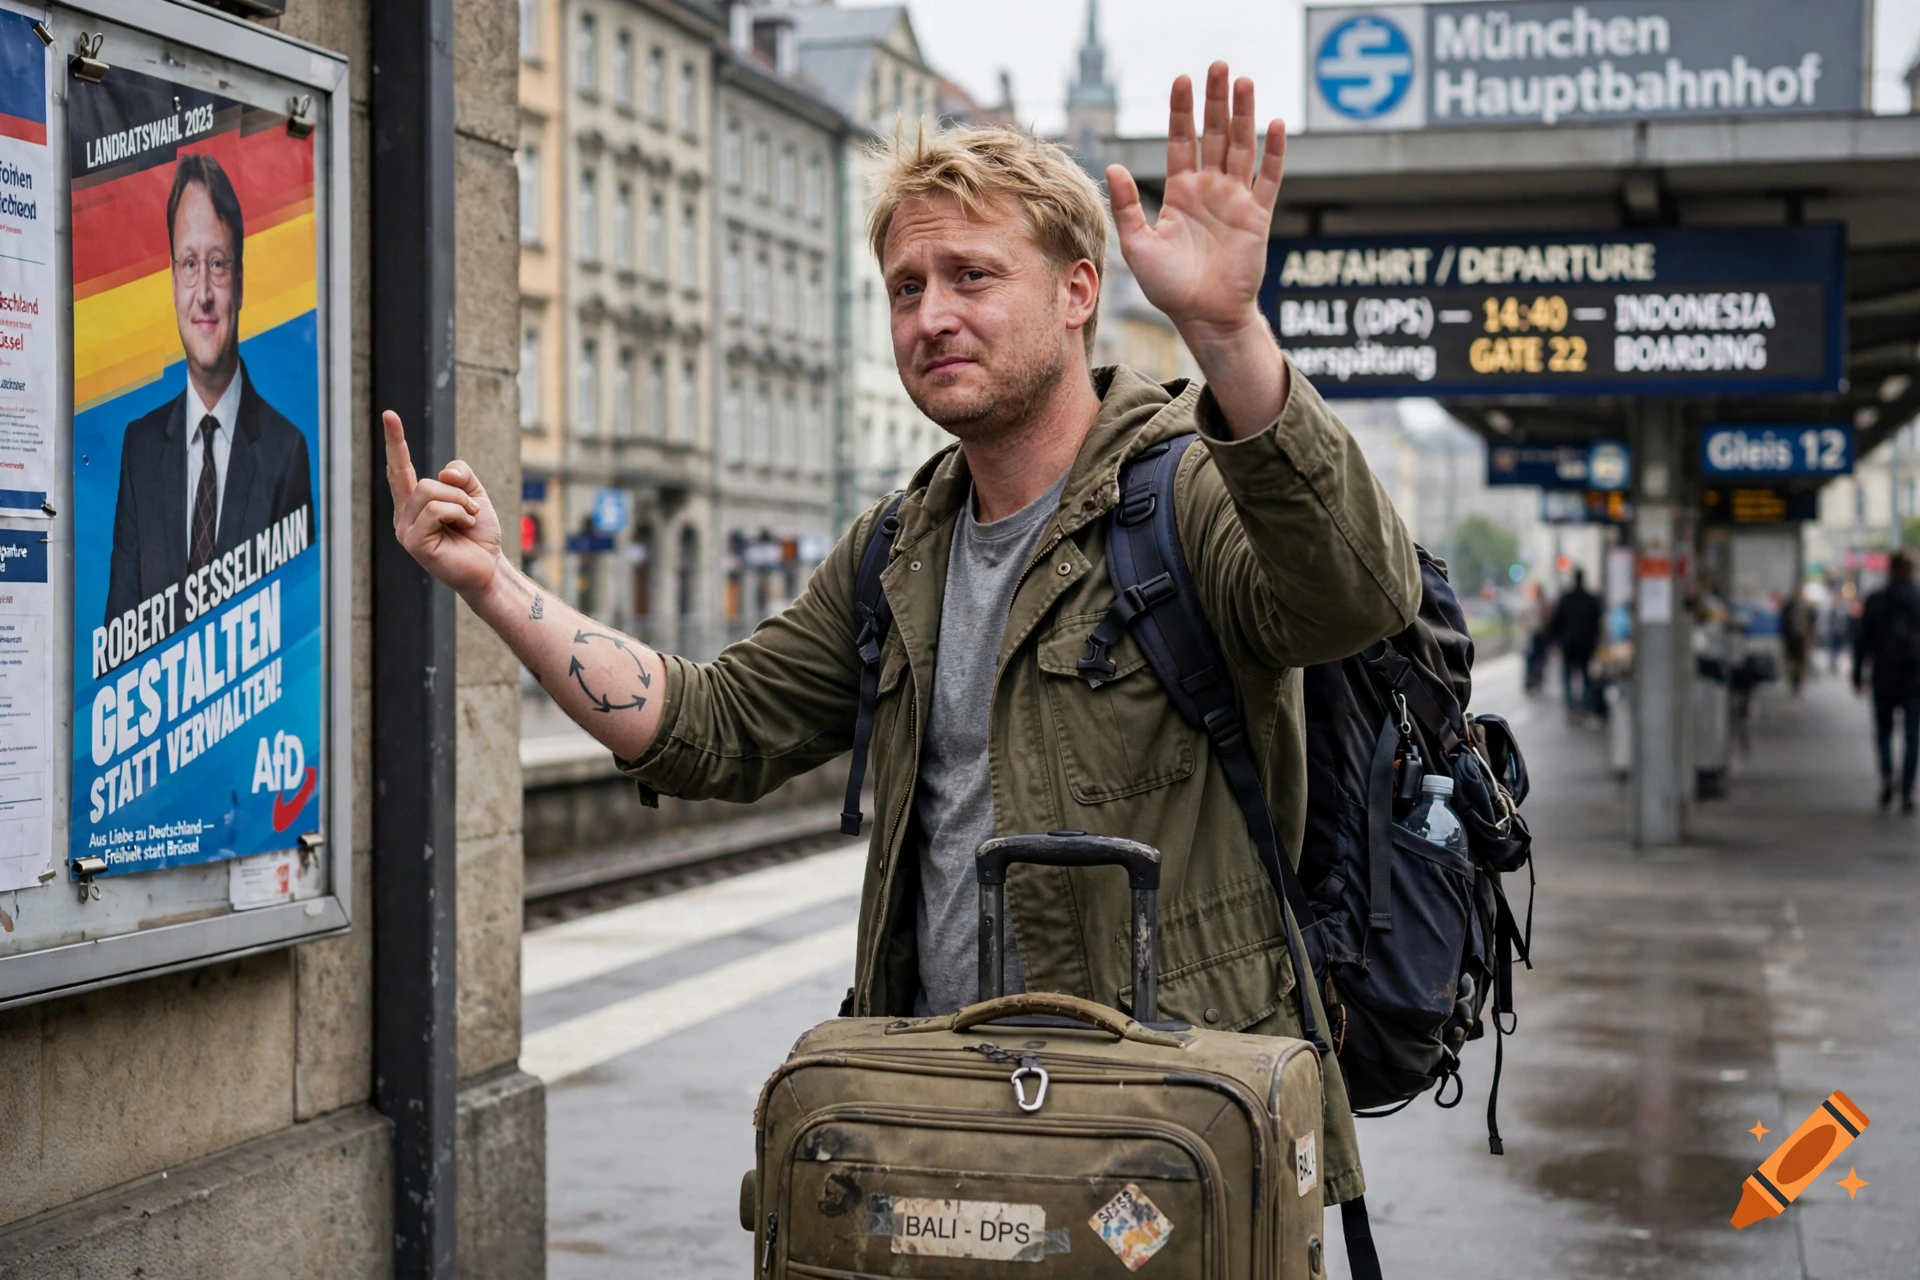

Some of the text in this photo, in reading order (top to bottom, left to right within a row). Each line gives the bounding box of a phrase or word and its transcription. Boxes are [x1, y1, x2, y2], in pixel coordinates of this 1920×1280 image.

[1434, 7, 1670, 62] München
[1434, 53, 1822, 124] Hauptbahnhof
[87, 103, 214, 168] LANDRATSWAHL 2023
[1280, 248, 1432, 287] ABFAHRT
[1458, 243, 1656, 284] DEPARTURE
[1280, 298, 1348, 336] BALI
[1353, 296, 1434, 340] (DPS)
[1483, 296, 1568, 333] 14:40
[1614, 292, 1776, 332] INDONESIA
[1469, 336, 1543, 374] GATE
[1547, 336, 1588, 373] 22
[1614, 333, 1767, 372] BOARDING
[1706, 429, 1847, 471] Gleis 12
[92, 503, 309, 680] ROBERT SESSELMANN
[91, 579, 281, 767] GESTALTEN
[90, 656, 282, 824] STATT VERWALTEN!
[251, 729, 305, 794] AfD
[89, 833, 107, 848] Aus
[136, 829, 147, 841] zu
[143, 841, 166, 860] statt
[906, 1216, 957, 1239] BALI
[980, 1220, 1030, 1245] DPS
